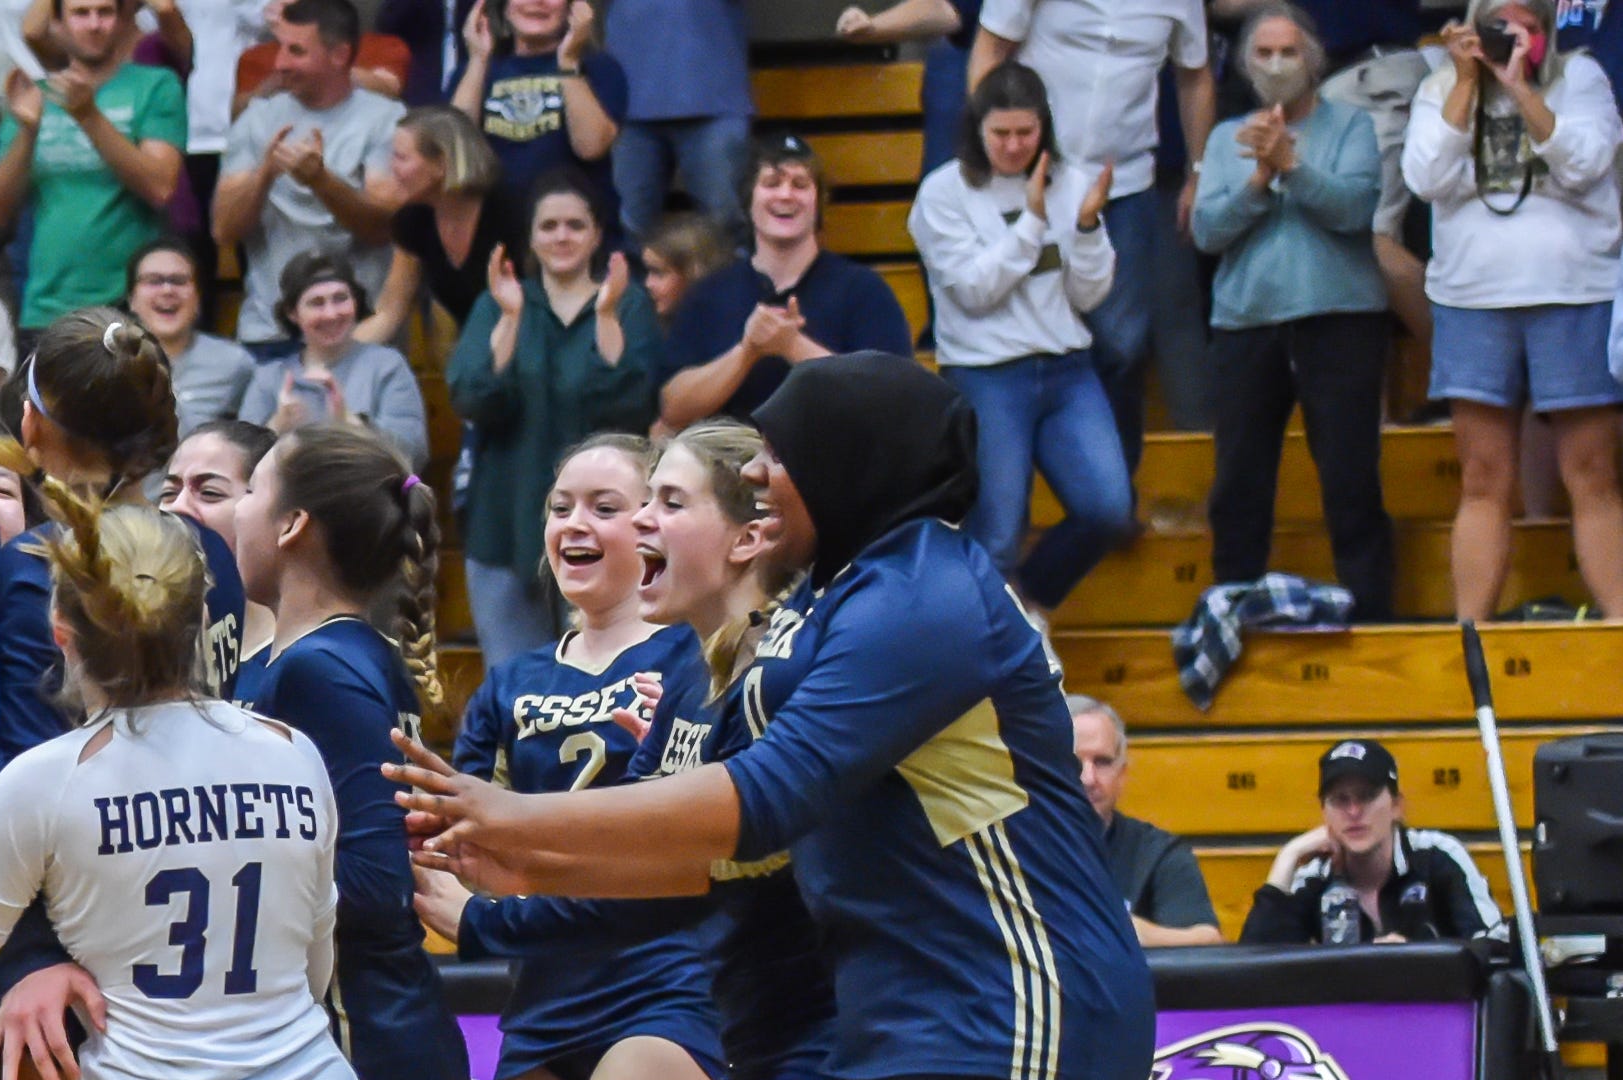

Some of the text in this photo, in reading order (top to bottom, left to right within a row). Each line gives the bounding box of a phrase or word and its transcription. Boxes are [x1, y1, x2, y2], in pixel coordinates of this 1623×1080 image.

[558, 730, 607, 793] 2
[93, 783, 318, 856] HORNETS
[132, 861, 263, 999] 31
